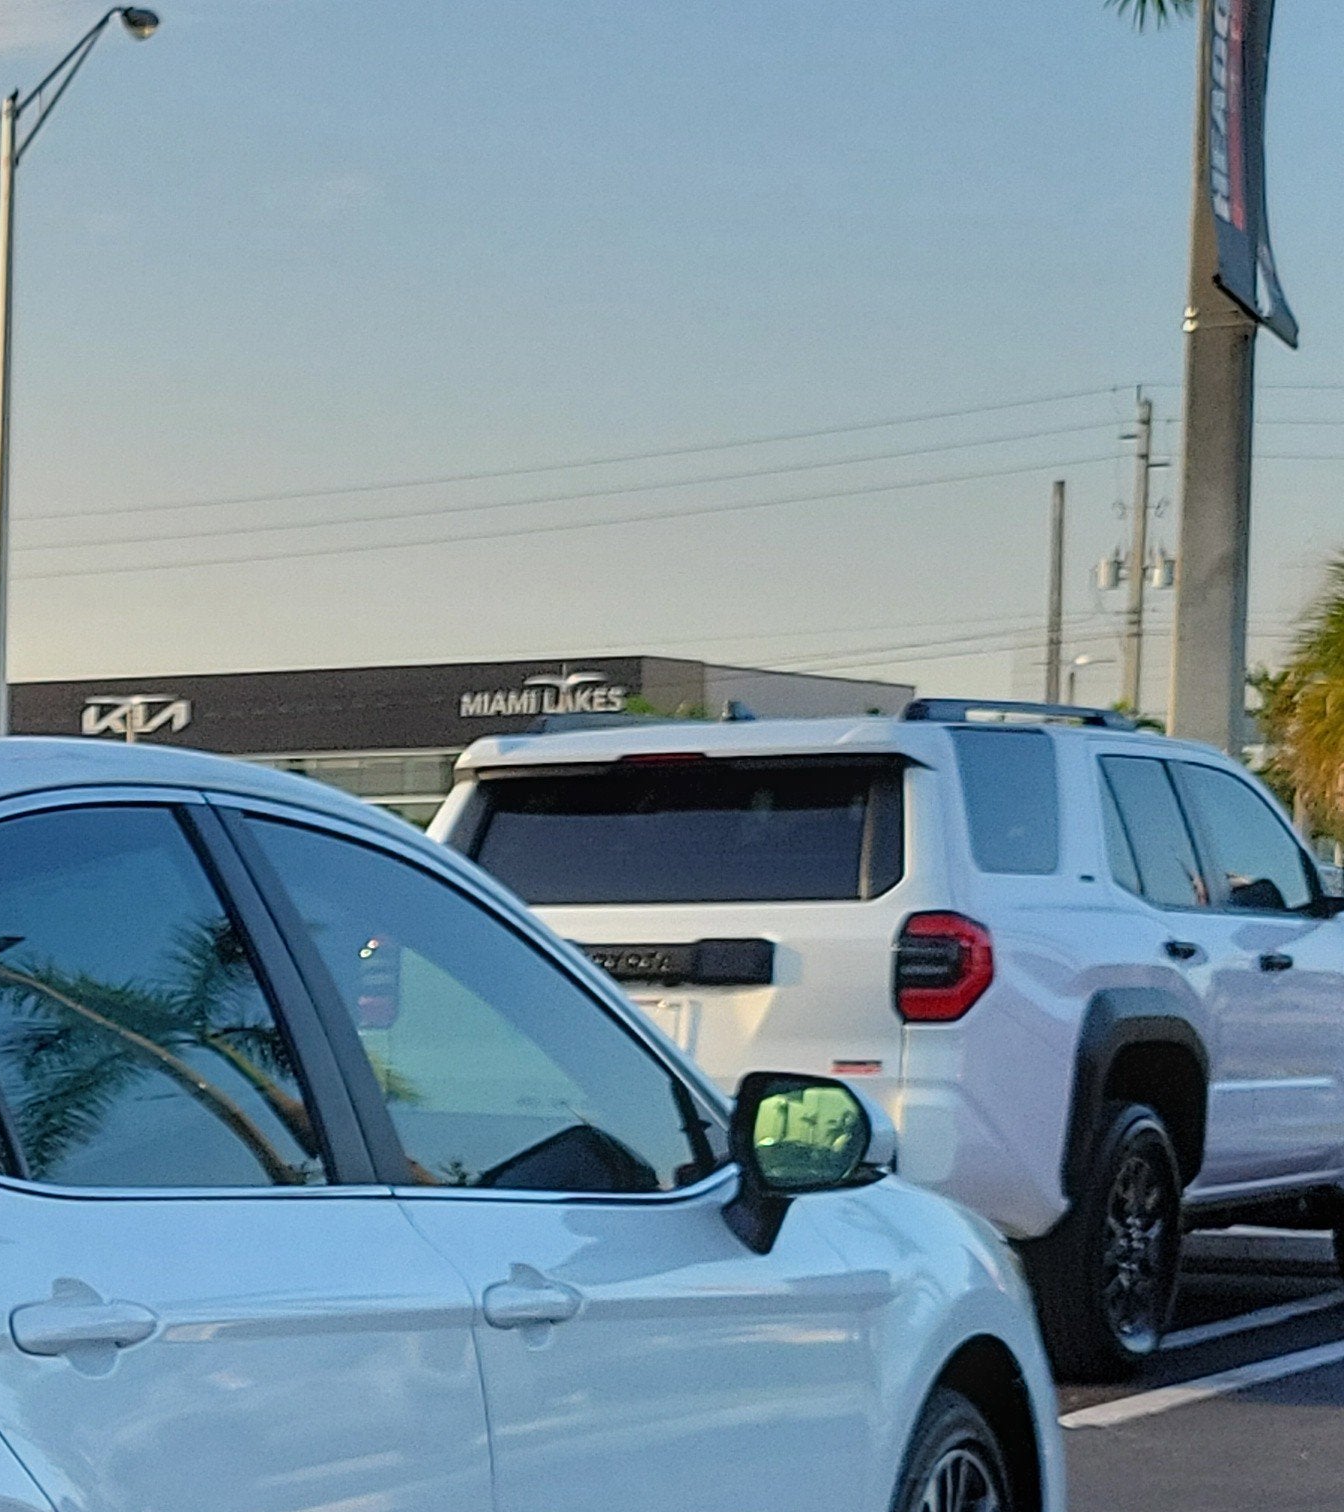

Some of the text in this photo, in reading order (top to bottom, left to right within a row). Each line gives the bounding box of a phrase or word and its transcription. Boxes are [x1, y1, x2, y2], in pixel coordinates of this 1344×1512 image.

[81, 700, 191, 735] KIA
[461, 685, 627, 717] MIAMI LAKES
